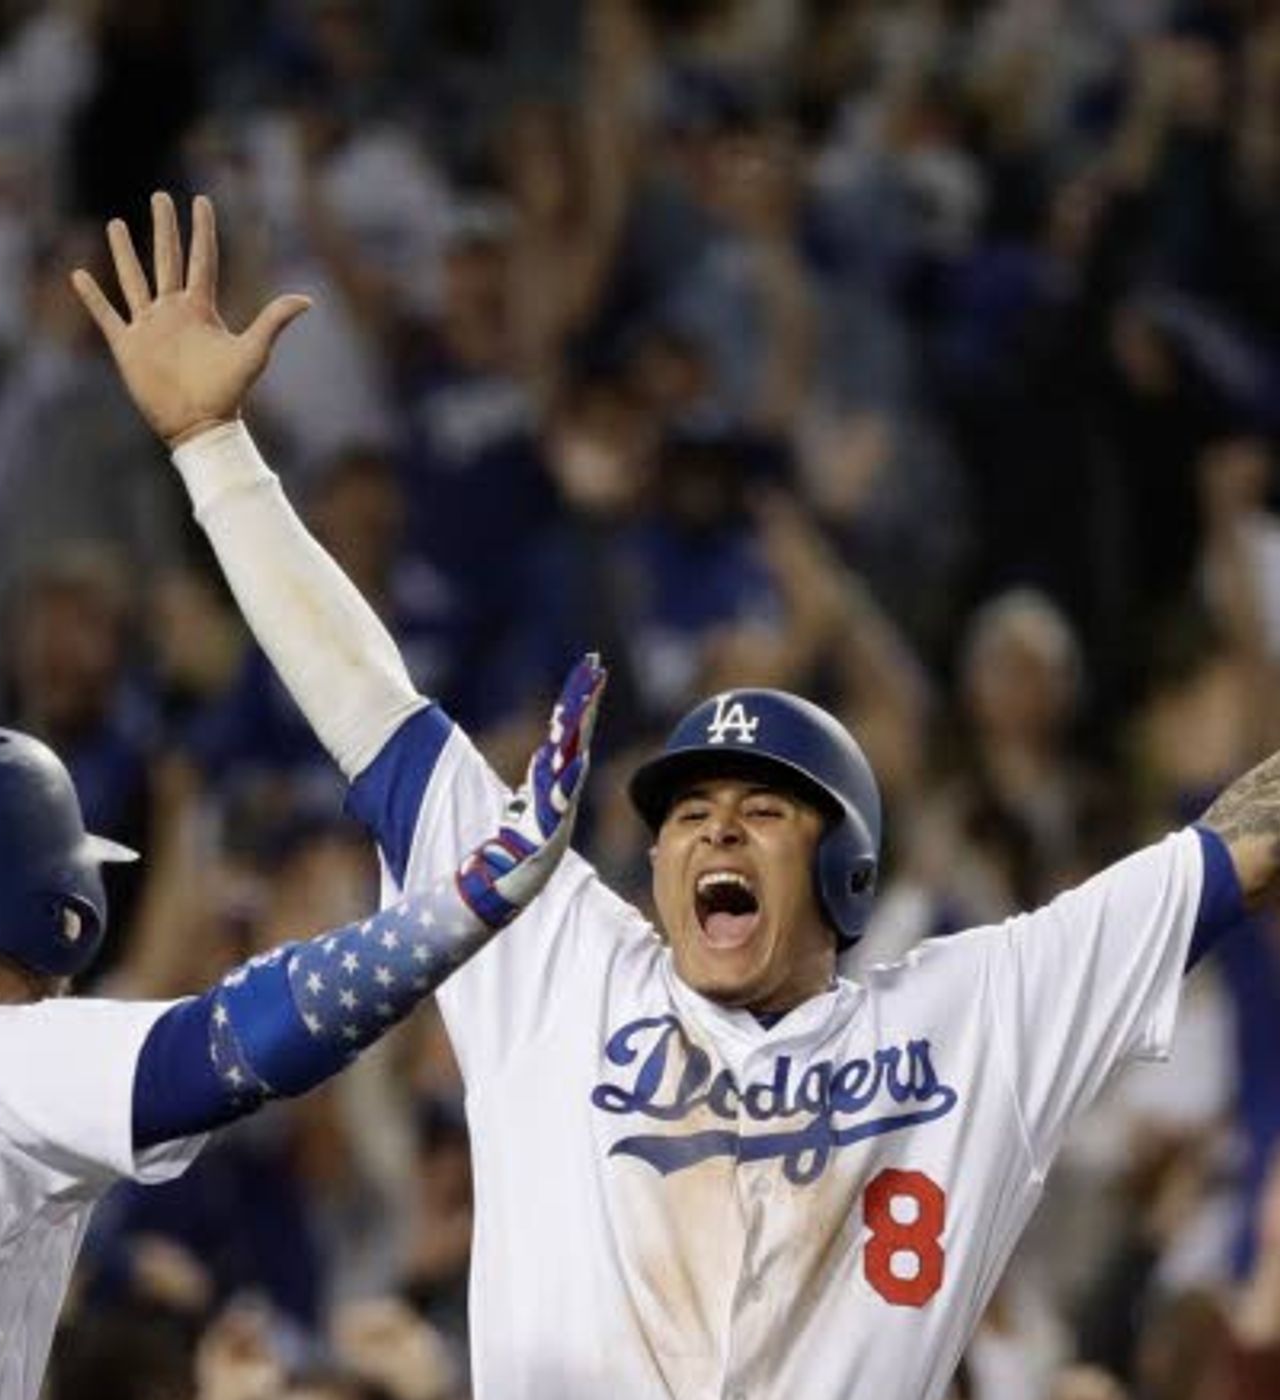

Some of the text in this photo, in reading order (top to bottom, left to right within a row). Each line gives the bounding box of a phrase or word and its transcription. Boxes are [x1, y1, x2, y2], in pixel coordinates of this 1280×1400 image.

[707, 694, 760, 744] LA
[590, 1014, 959, 1185] Dodgers
[863, 1167, 946, 1308] 8
